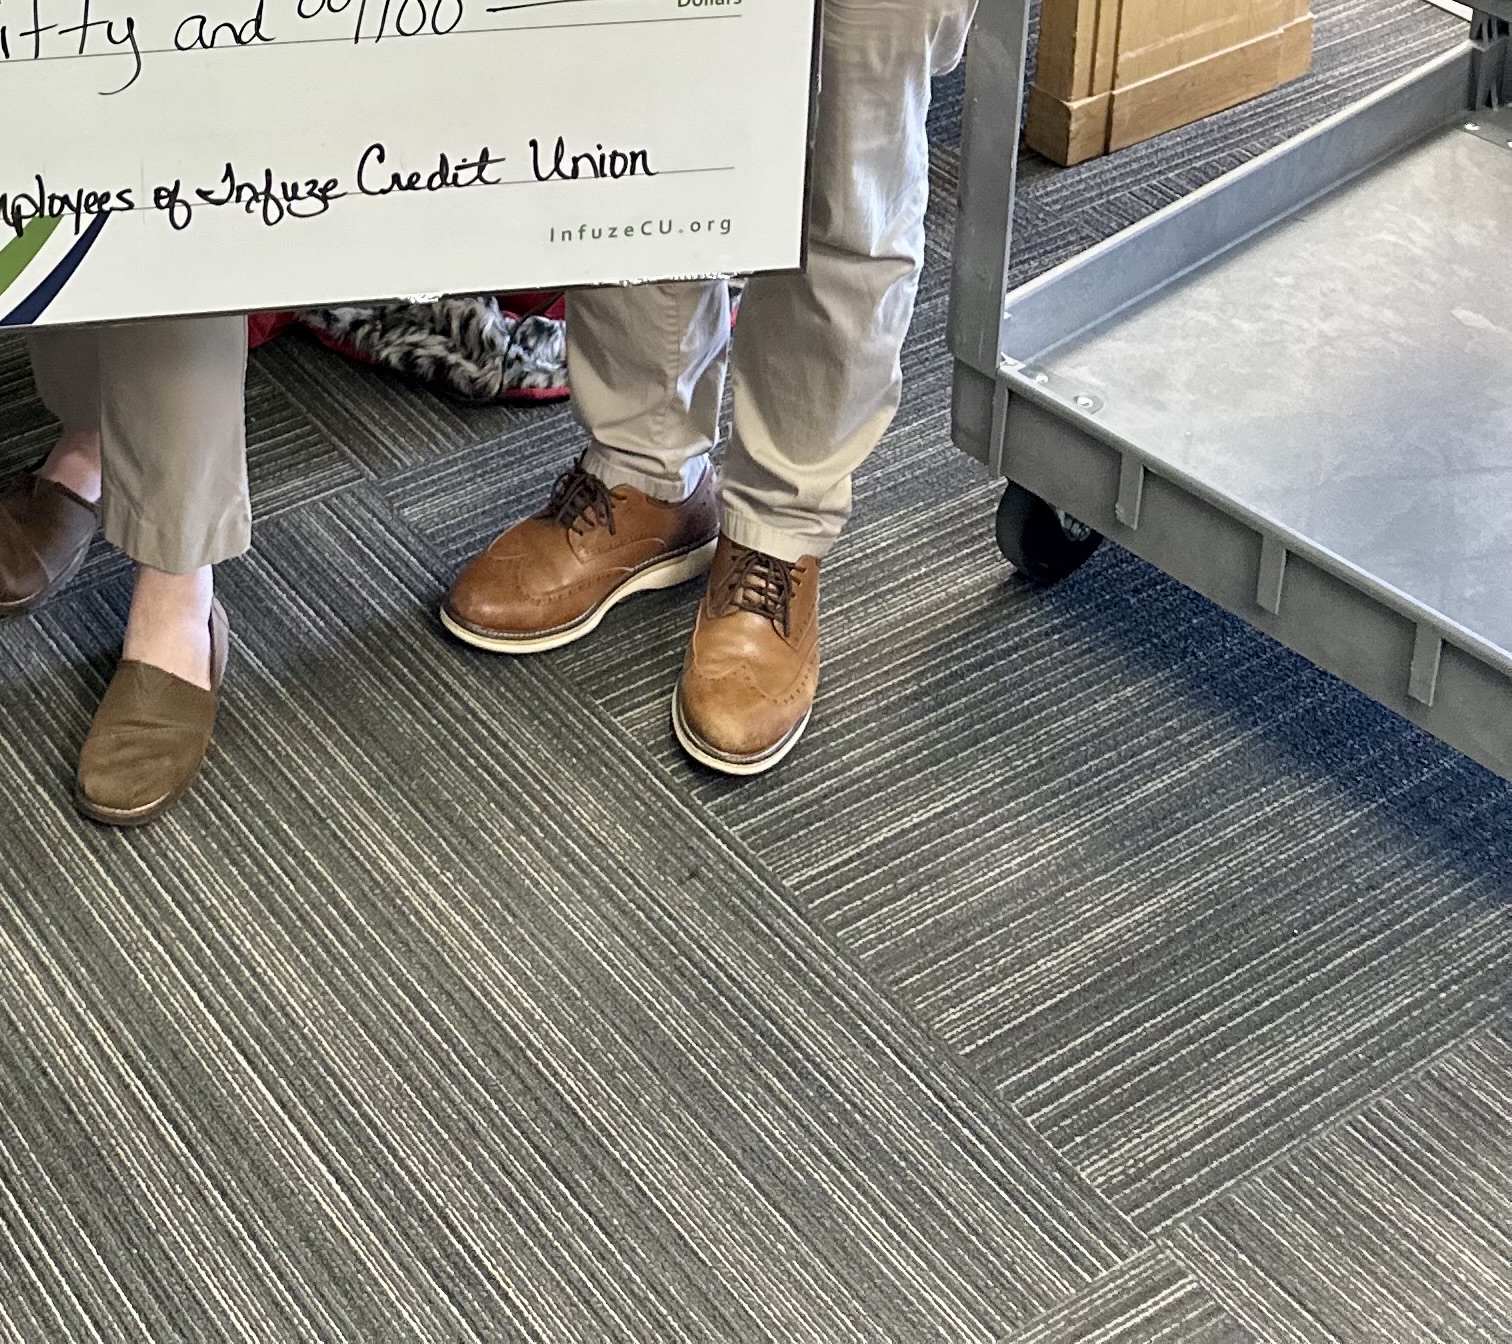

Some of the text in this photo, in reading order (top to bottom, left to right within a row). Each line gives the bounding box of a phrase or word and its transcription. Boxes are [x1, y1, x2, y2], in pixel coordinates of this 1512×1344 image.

[153, 178, 192, 230] of
[195, 162, 350, 226] Infuze
[356, 142, 507, 196] Credit
[529, 135, 660, 181] Union
[549, 216, 733, 244] InfuzeCU.org
